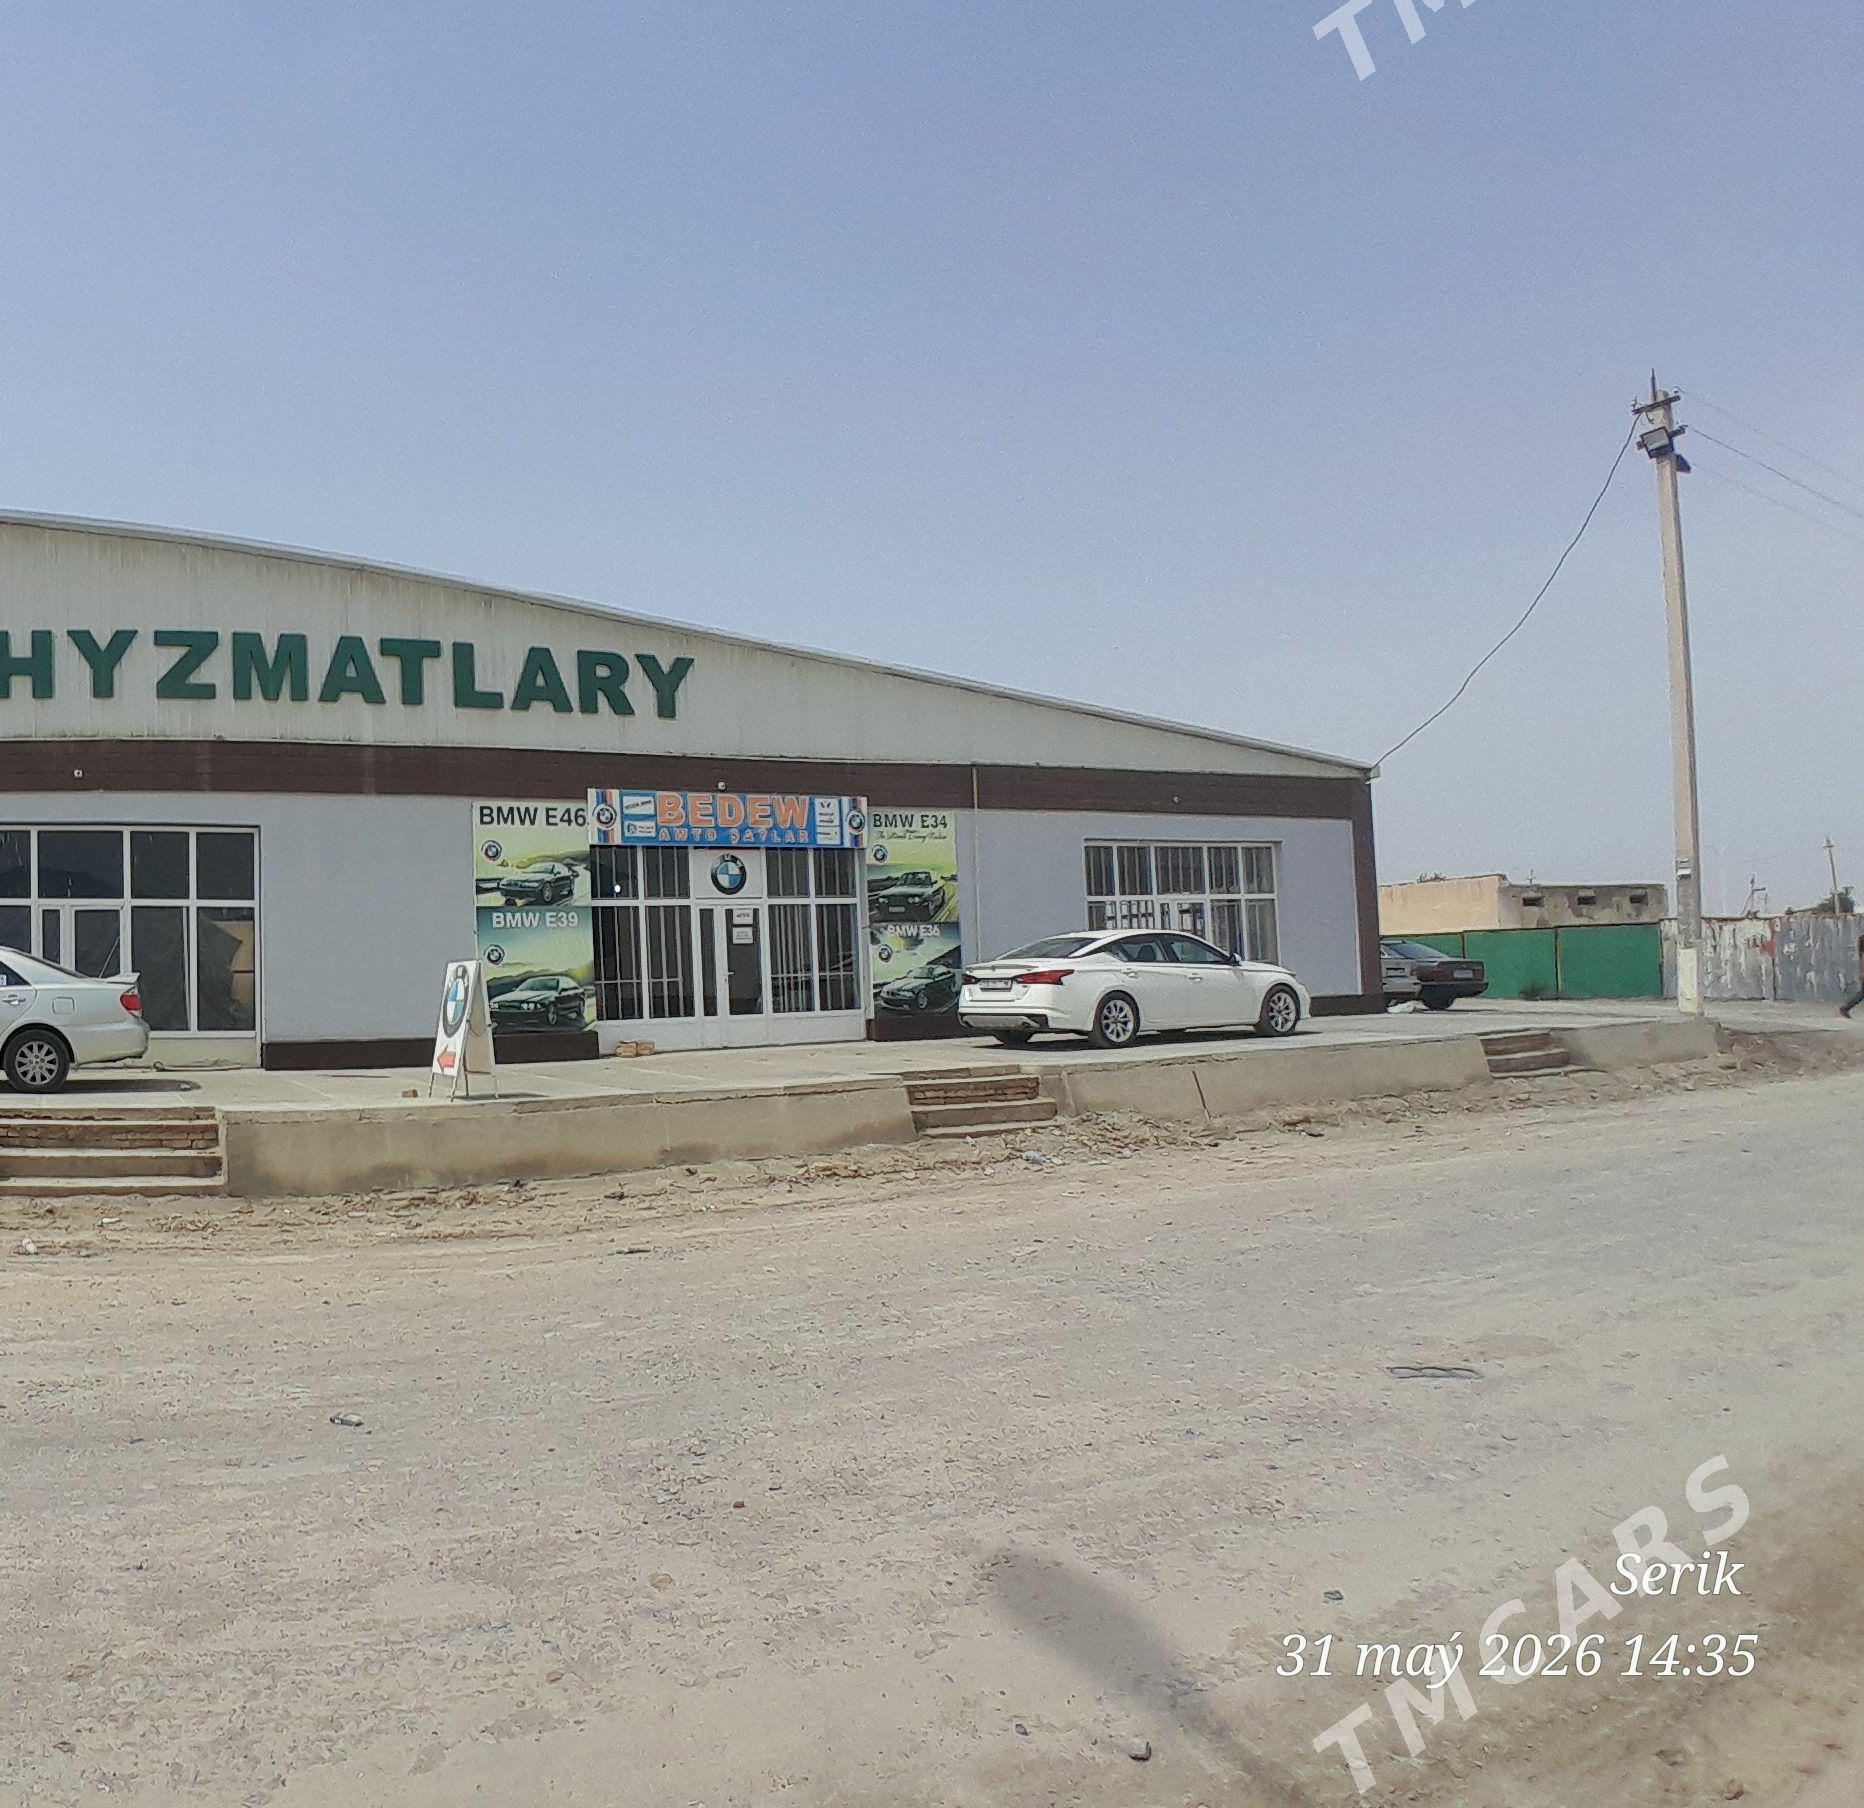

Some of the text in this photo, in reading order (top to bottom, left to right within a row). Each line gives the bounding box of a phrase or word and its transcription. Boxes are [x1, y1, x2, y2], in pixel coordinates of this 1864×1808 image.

[479, 806, 587, 827] BMW E46
[655, 792, 810, 829] BEDEW
[873, 813, 948, 829] BMW E34
[492, 911, 578, 928] BMW E39
